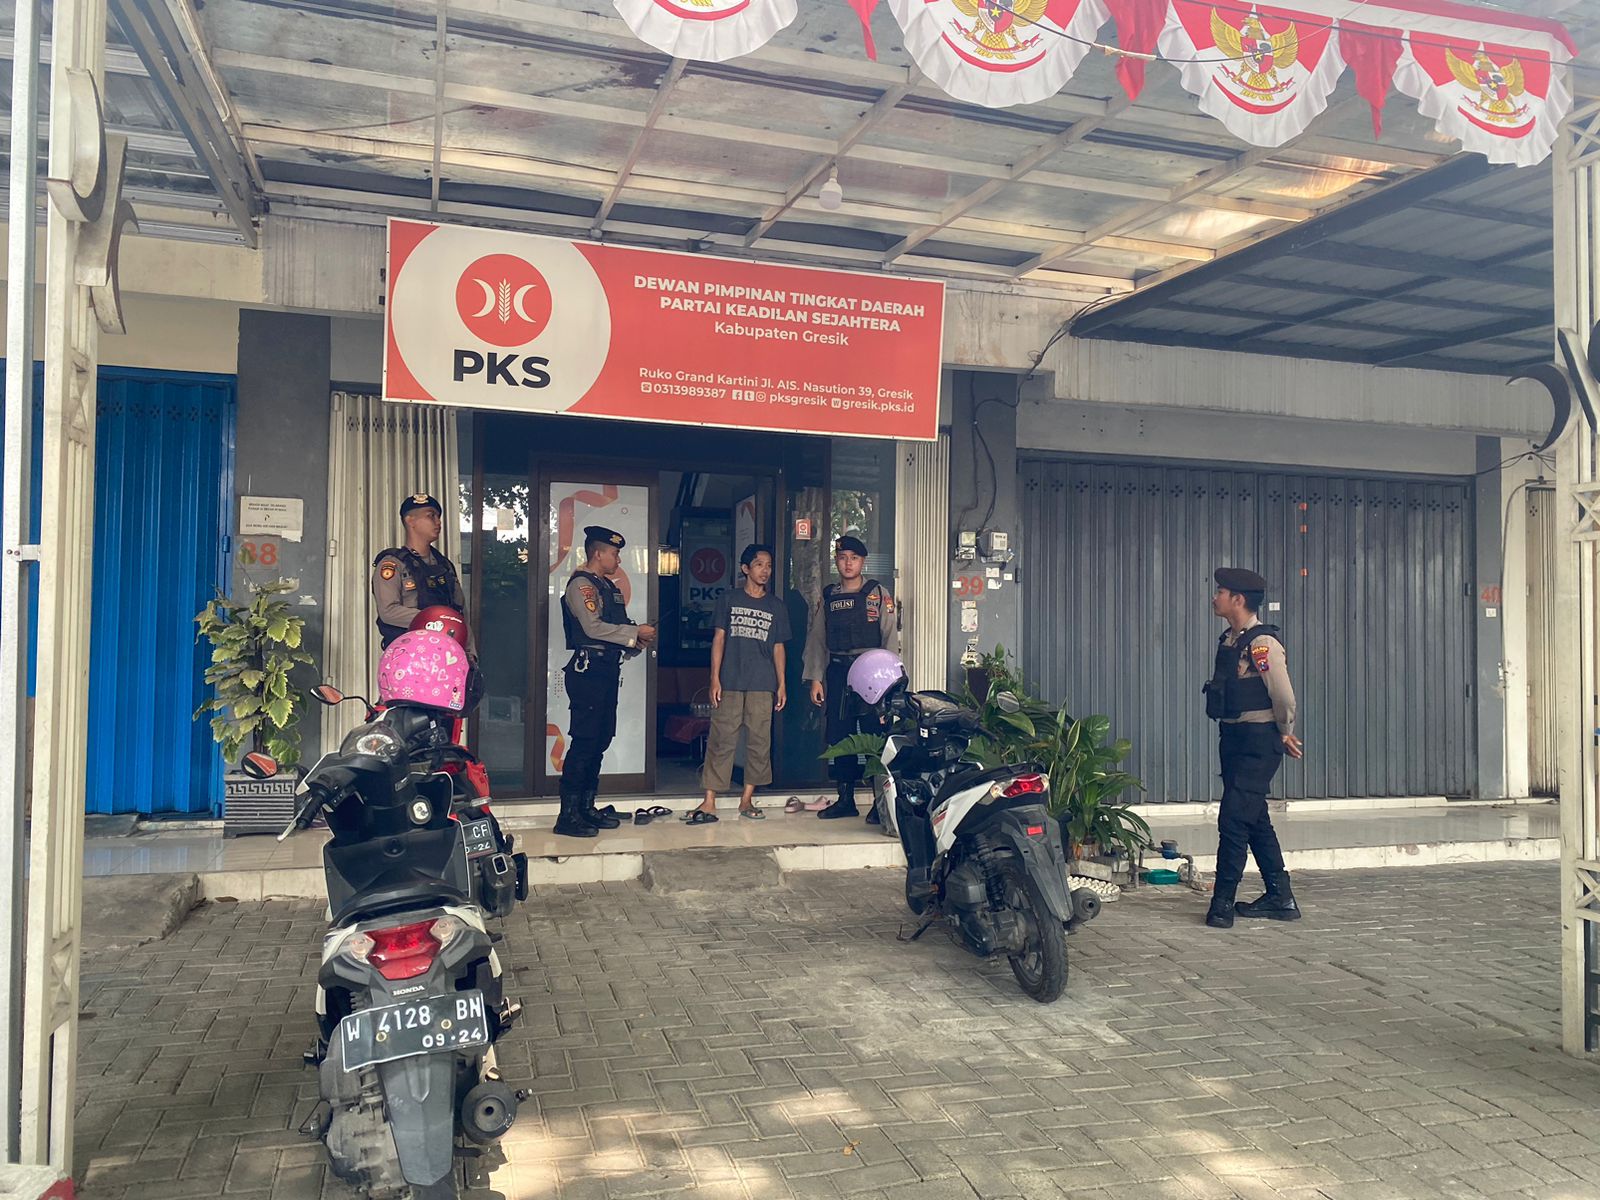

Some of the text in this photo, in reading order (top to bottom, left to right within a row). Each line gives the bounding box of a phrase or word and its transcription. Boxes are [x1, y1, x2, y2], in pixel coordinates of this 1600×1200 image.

[634, 275, 924, 317] DEWAN PIMPINAN TINGKAT DAERAH
[660, 296, 901, 332] PARTAI KEADILAN SEJAHTERA
[715, 321, 849, 345] Kabupaten Gresik
[453, 349, 550, 388] PKS
[639, 367, 672, 380] Ruko
[675, 370, 714, 384] Grand
[717, 374, 758, 387] Kartini
[761, 378, 774, 388] Jl.
[803, 382, 855, 395] Nasution
[858, 386, 875, 398] 39,
[877, 388, 913, 400] Gresik
[653, 383, 726, 398] 0313989387
[769, 392, 827, 406] pksgresik
[842, 399, 915, 413] gresik.pks.id
[955, 576, 984, 596] 39
[731, 615, 772, 631] LONDON
[731, 625, 769, 642] BERLIN
[472, 823, 488, 838] CF
[392, 985, 425, 995] HONDA
[346, 996, 482, 1042] W 4128 BN
